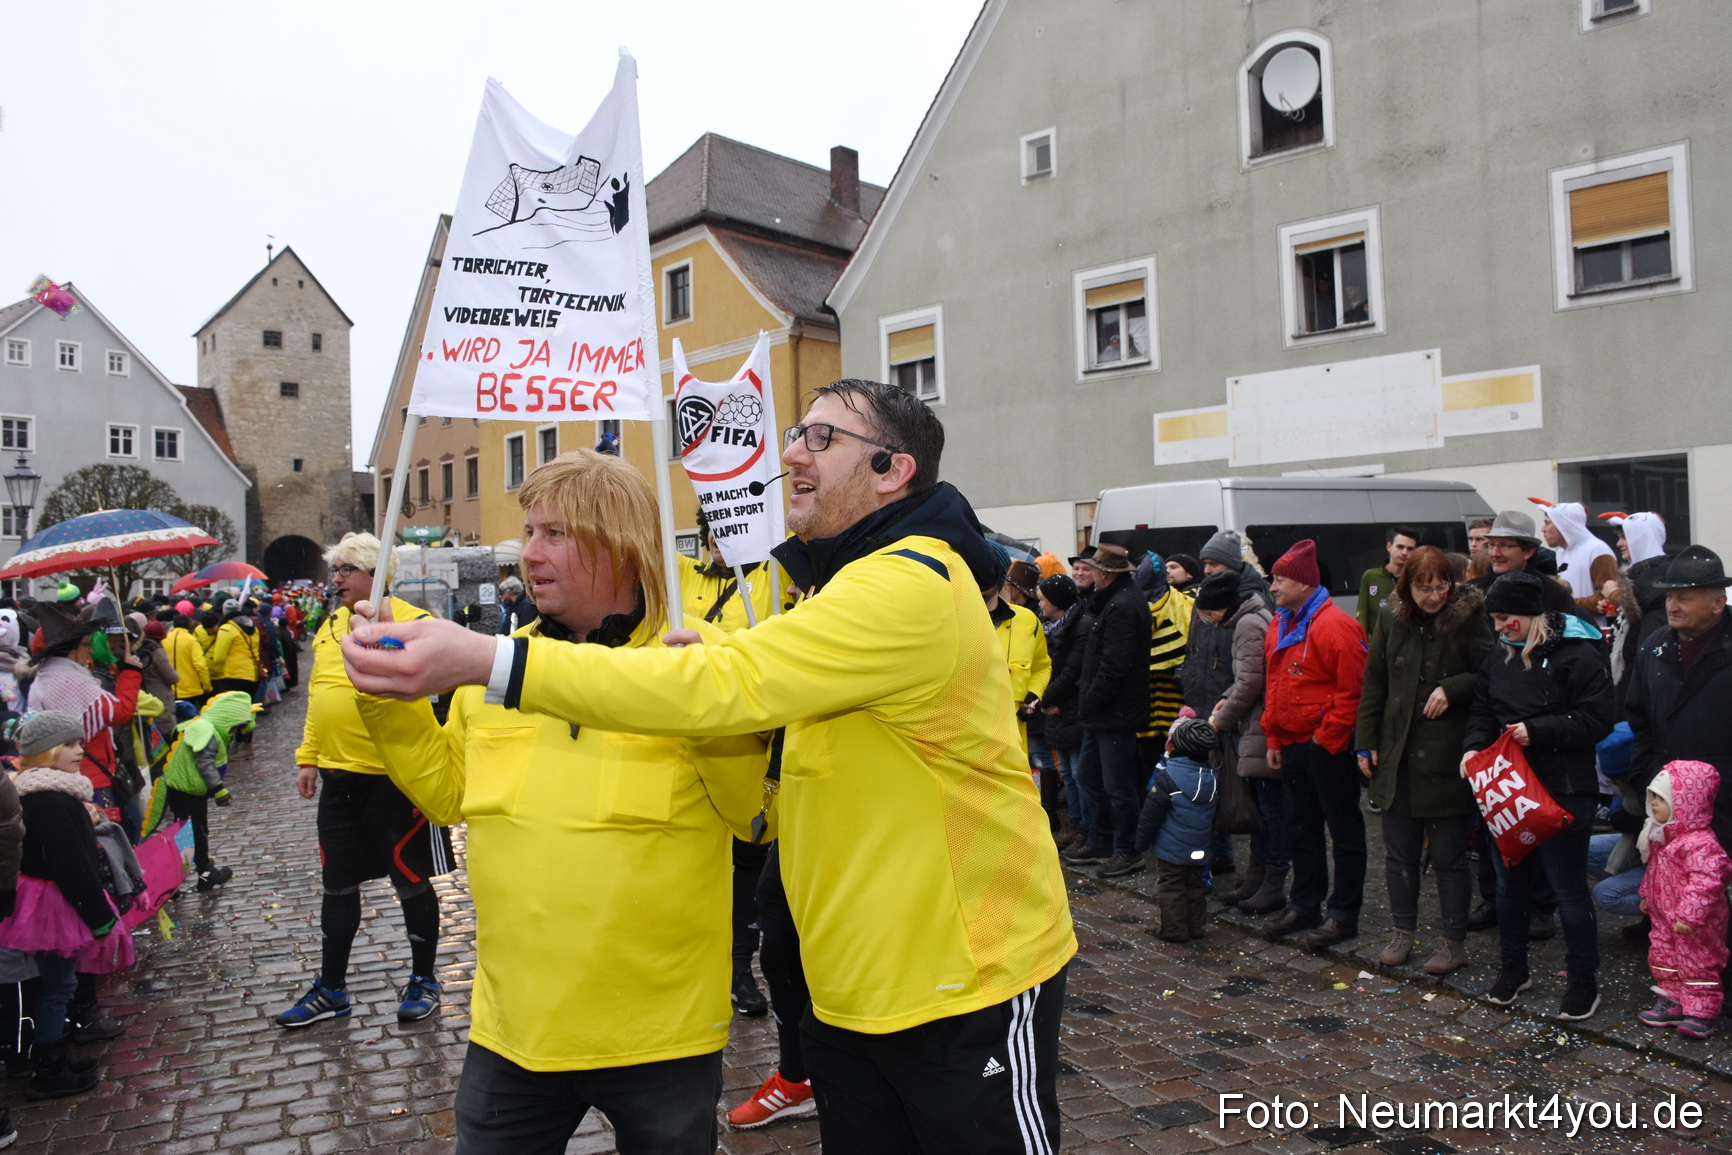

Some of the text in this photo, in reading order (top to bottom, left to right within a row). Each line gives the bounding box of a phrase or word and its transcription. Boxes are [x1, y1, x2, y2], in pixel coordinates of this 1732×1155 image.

[452, 257, 551, 284] TORRICHTER,
[444, 307, 562, 328] VIDEOBEWEIS
[509, 339, 551, 370] JA
[568, 337, 645, 375] IMMER
[476, 372, 618, 412] BESSER
[710, 425, 758, 448] FIFA
[715, 487, 749, 502] MACHT
[733, 502, 764, 517] SPORT
[713, 523, 749, 539] KAPUTT
[678, 539, 694, 549] BW
[481, 586, 494, 598] 29
[1467, 754, 1513, 796] MIA
[1476, 770, 1527, 818] SAN
[1487, 795, 1541, 839] MIA
[982, 1065, 1005, 1078] adidas
